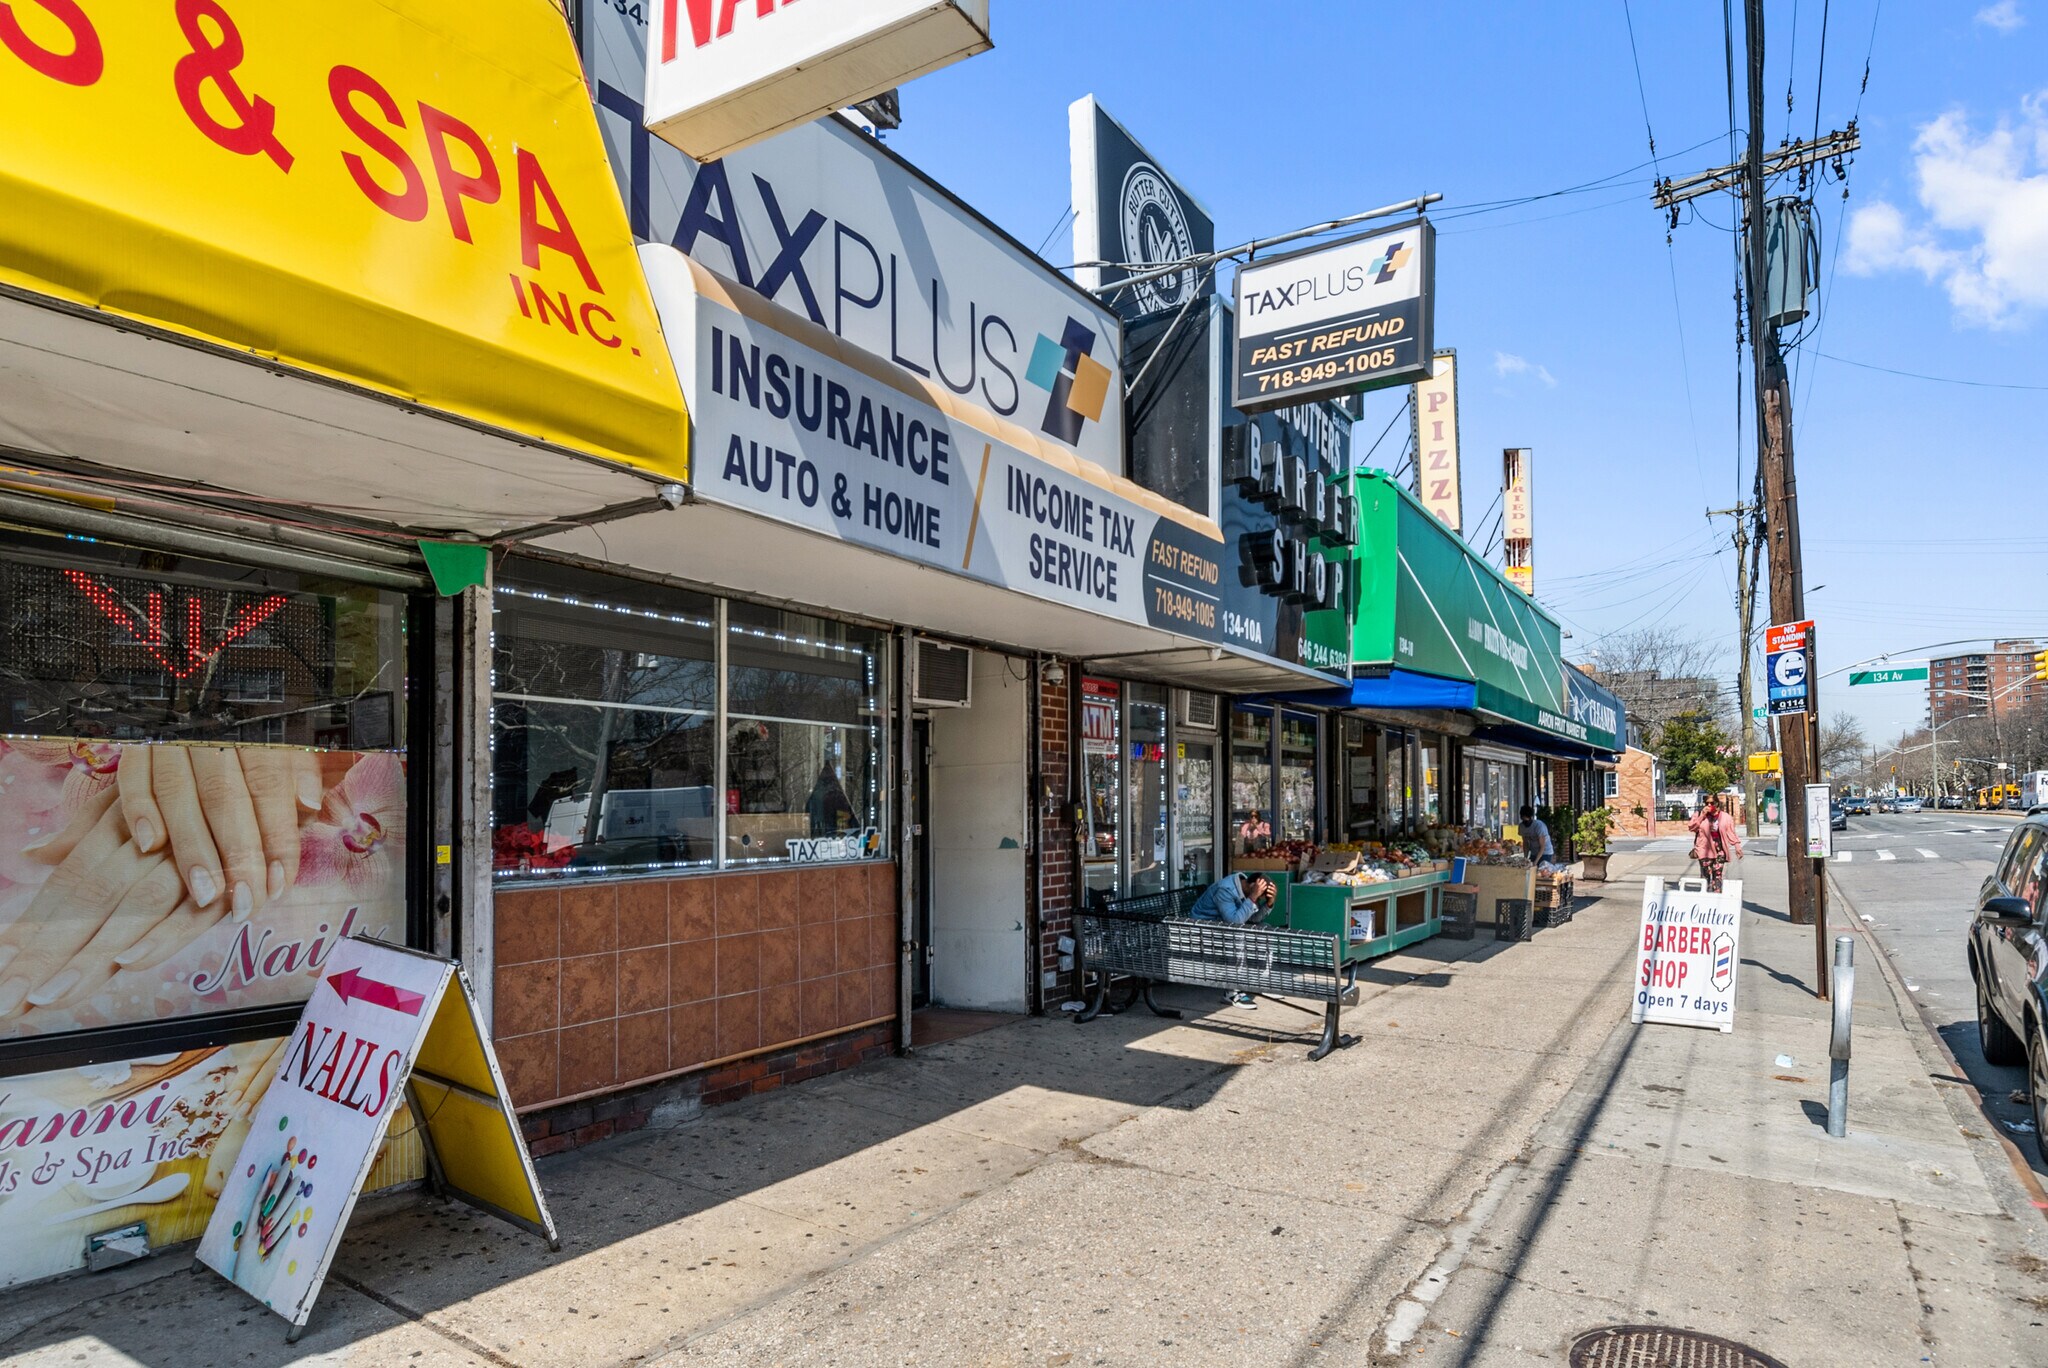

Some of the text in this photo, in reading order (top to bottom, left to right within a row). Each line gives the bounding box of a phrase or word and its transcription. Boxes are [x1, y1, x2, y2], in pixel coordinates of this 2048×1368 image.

[174, 0, 295, 174] &
[328, 65, 605, 295] SPA
[1128, 179, 1156, 218] BUTTER
[1244, 266, 1364, 316] TAXPLUS
[509, 273, 641, 357] INC.
[1251, 317, 1405, 366] FAST REFUND
[1259, 349, 1395, 392] 718-949-1005
[711, 326, 949, 486] INSURANCE
[1427, 391, 1455, 528] PIZZA
[722, 433, 941, 549] AUTO & HOME
[1250, 422, 1360, 545] BARBER
[1512, 478, 1525, 520] RIED
[1007, 465, 1136, 558] INCOME TAX
[1029, 533, 1118, 602] SERVICE
[1152, 539, 1219, 585] FAST REFUND
[1272, 528, 1343, 610] SHOP
[1155, 587, 1216, 629] 718-949-1005
[1222, 610, 1262, 644] 134-10A
[1783, 625, 1796, 634] NO
[1297, 637, 1312, 661] 646
[1313, 643, 1328, 665] 244
[1781, 687, 1801, 697] Q111
[1873, 671, 1903, 682] 134 Av
[1083, 706, 1112, 739] ATM
[1538, 710, 1554, 729] AARON
[1554, 716, 1566, 732] FRUIT
[1780, 699, 1805, 708] Q114
[788, 838, 858, 860] TAXPLUS
[1647, 901, 1735, 926] Butter Cutterz
[193, 907, 387, 992] Nail
[1644, 924, 1711, 955] BARBER
[1641, 958, 1688, 989] SHOP
[1638, 991, 1728, 1015] Open 7 days
[280, 1021, 403, 1118] NAILS
[0, 1081, 182, 1150] anni
[72, 1146, 133, 1185] Spa
[141, 1133, 193, 1165] Inc
